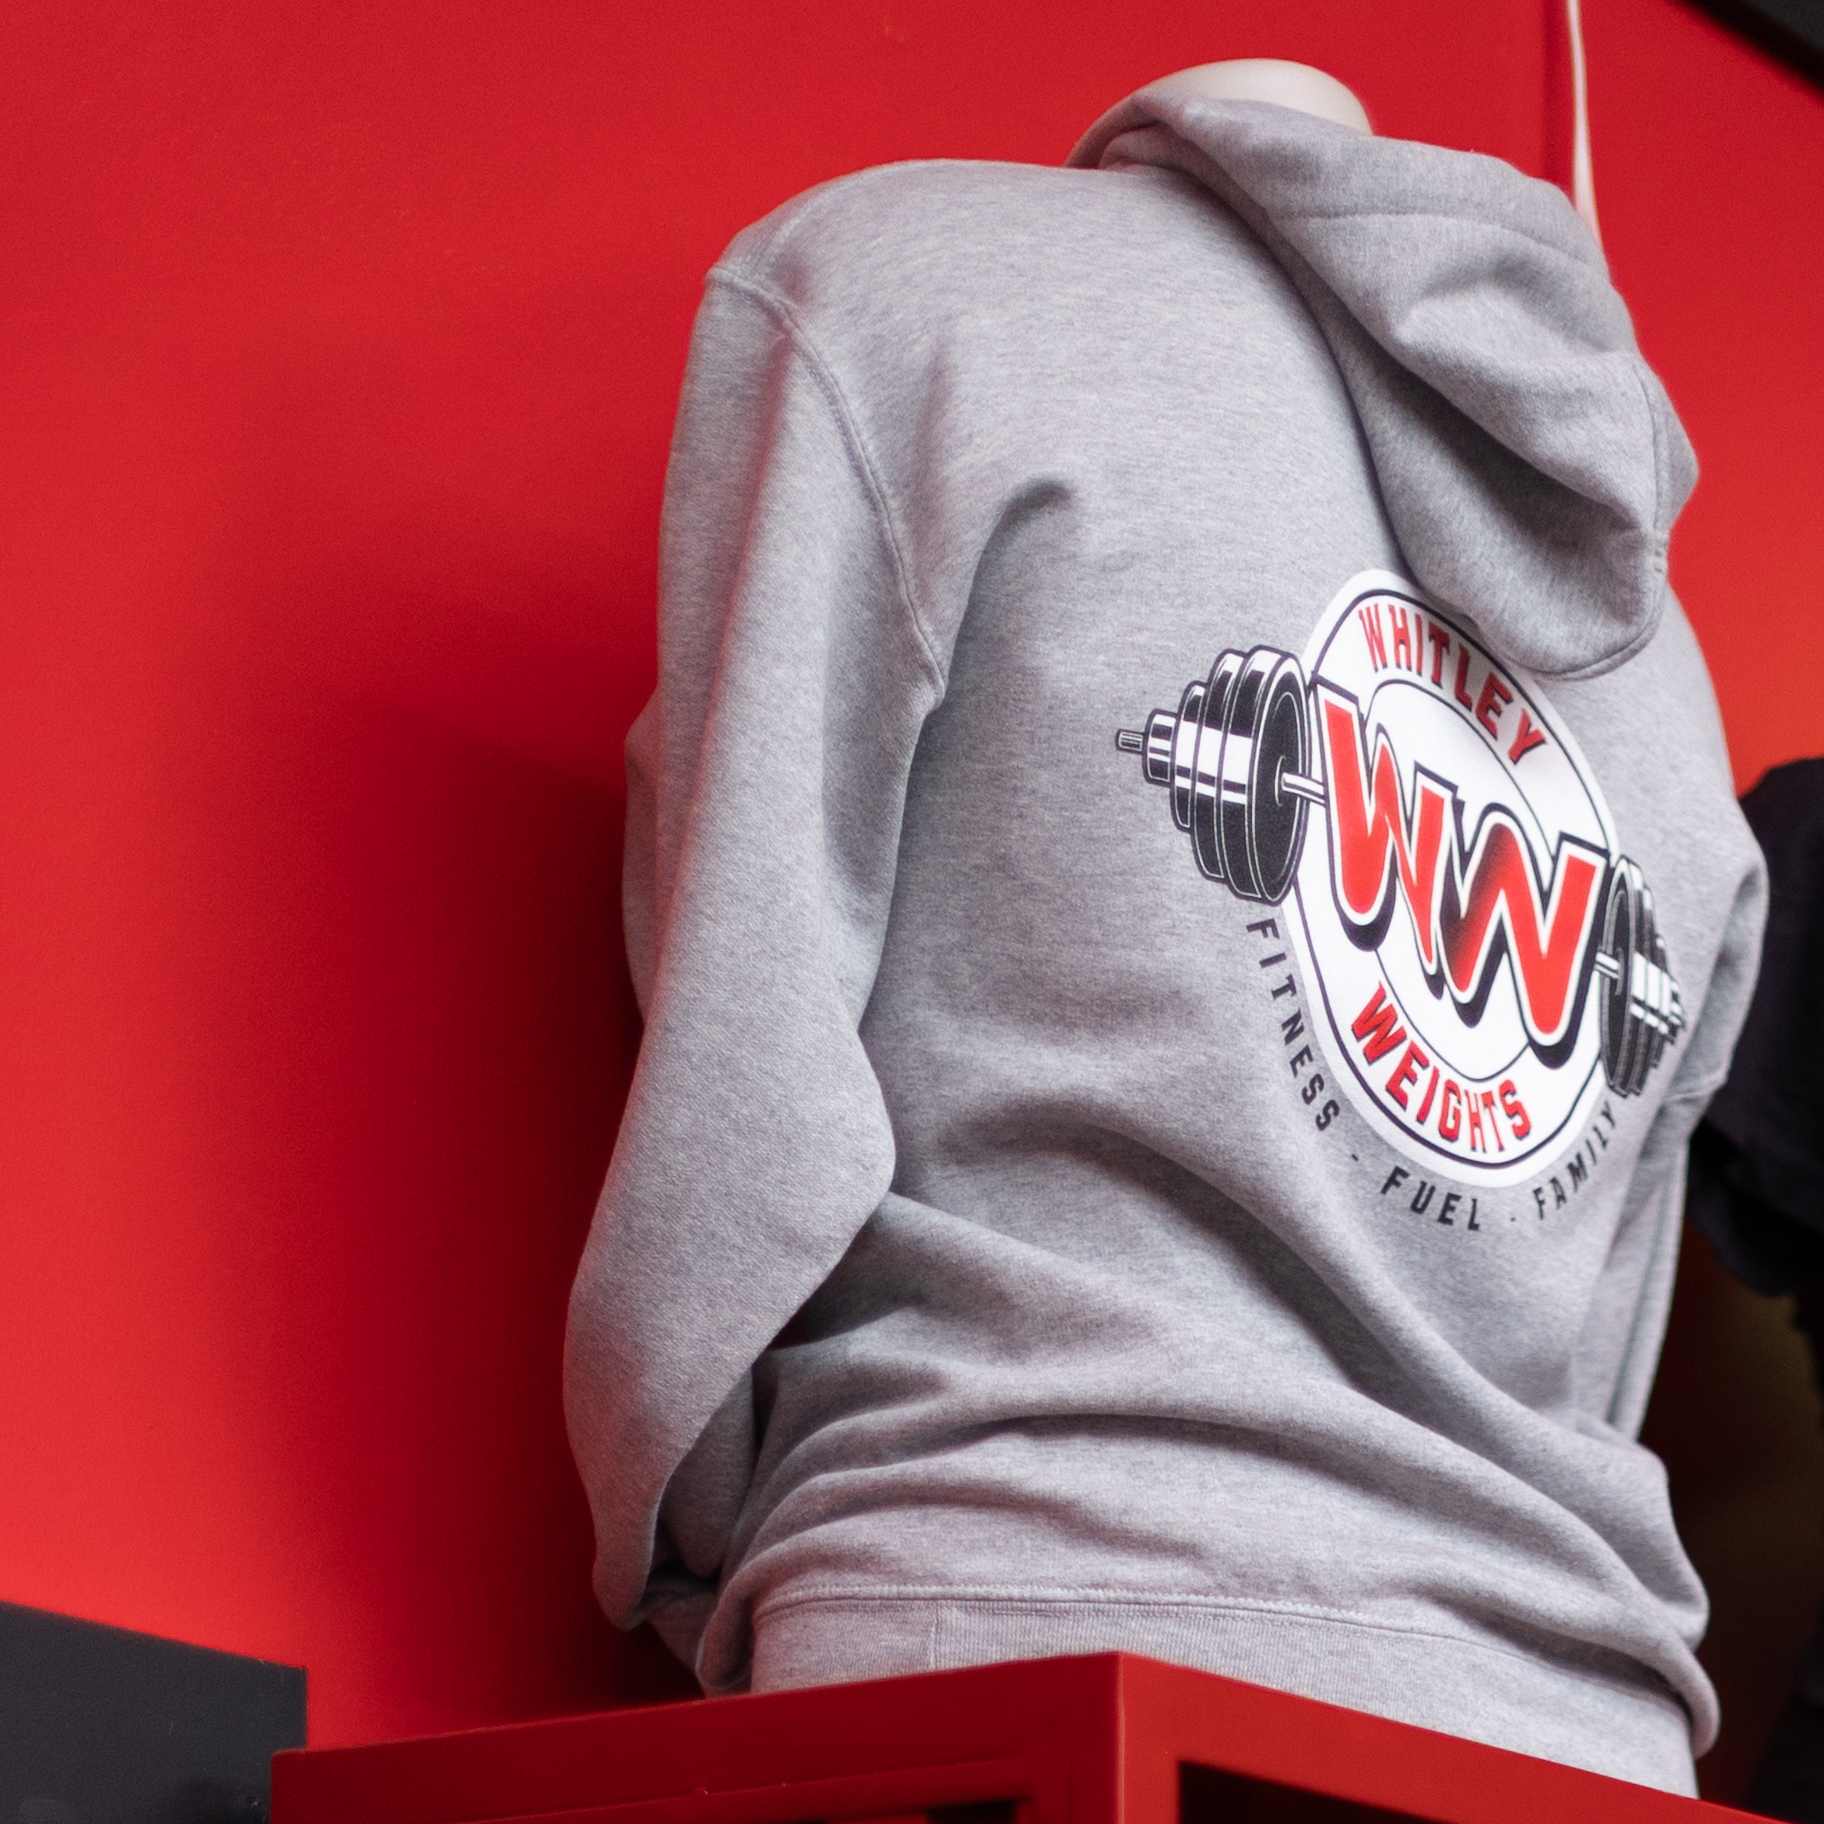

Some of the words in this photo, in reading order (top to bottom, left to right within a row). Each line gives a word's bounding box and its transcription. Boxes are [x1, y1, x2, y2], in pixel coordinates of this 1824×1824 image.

[1358, 602, 1548, 764] WHITLEY
[1245, 916, 1342, 1132] FITNESS
[1379, 1164, 1482, 1232] FUEL
[1532, 1104, 1620, 1220] FAMILY
[1350, 980, 1532, 1154] WEIGHTS
